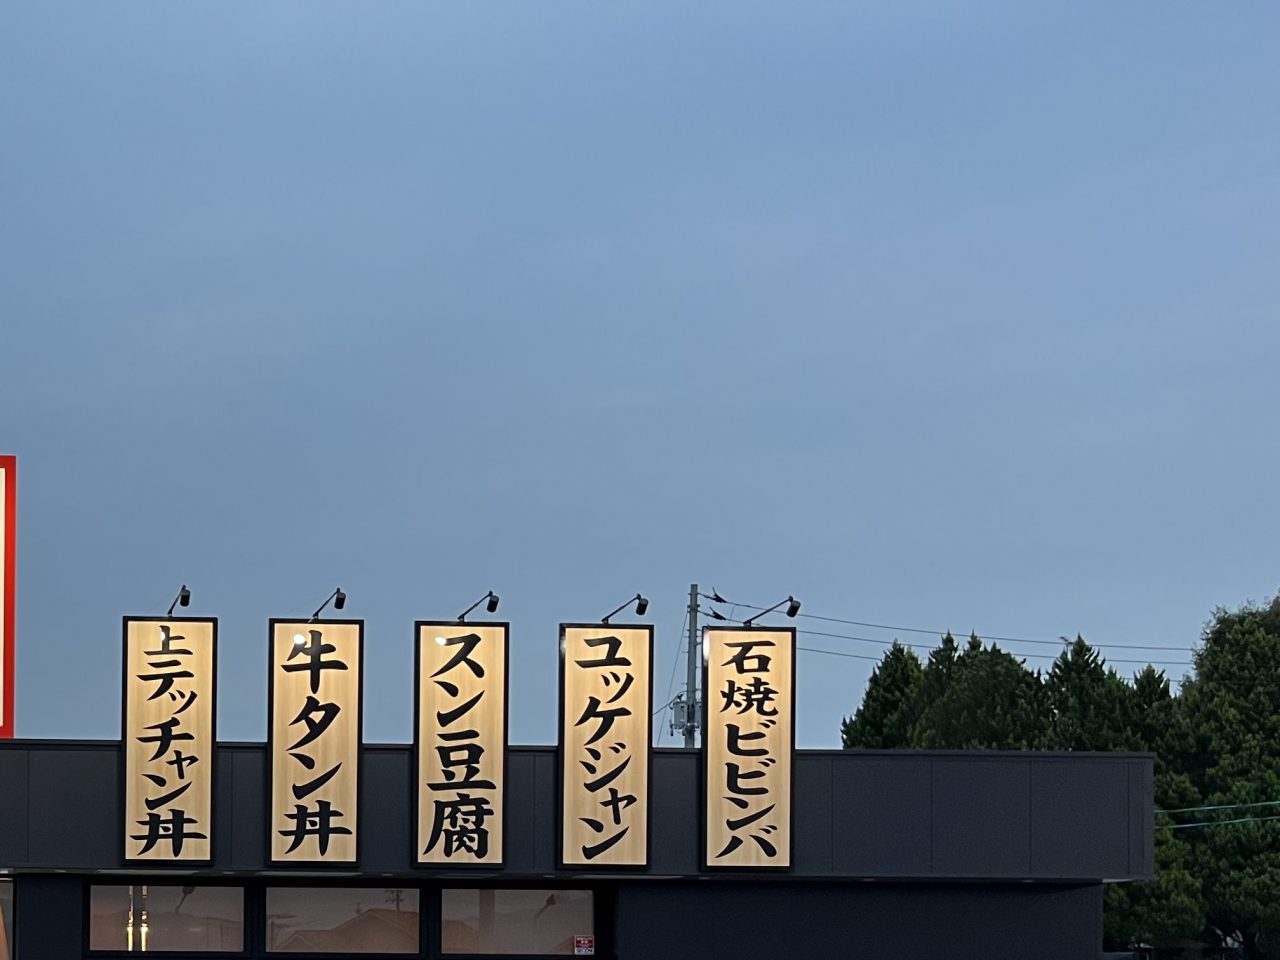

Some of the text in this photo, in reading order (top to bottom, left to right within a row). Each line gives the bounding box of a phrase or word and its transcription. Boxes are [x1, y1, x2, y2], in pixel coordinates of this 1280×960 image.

[129, 624, 209, 858] 上テッチャン丼
[277, 629, 354, 858] 牛タン丼
[421, 632, 498, 860] スン豆腐
[573, 635, 638, 860] ユッケジャン
[713, 639, 780, 859] 石焼ビビンバ
